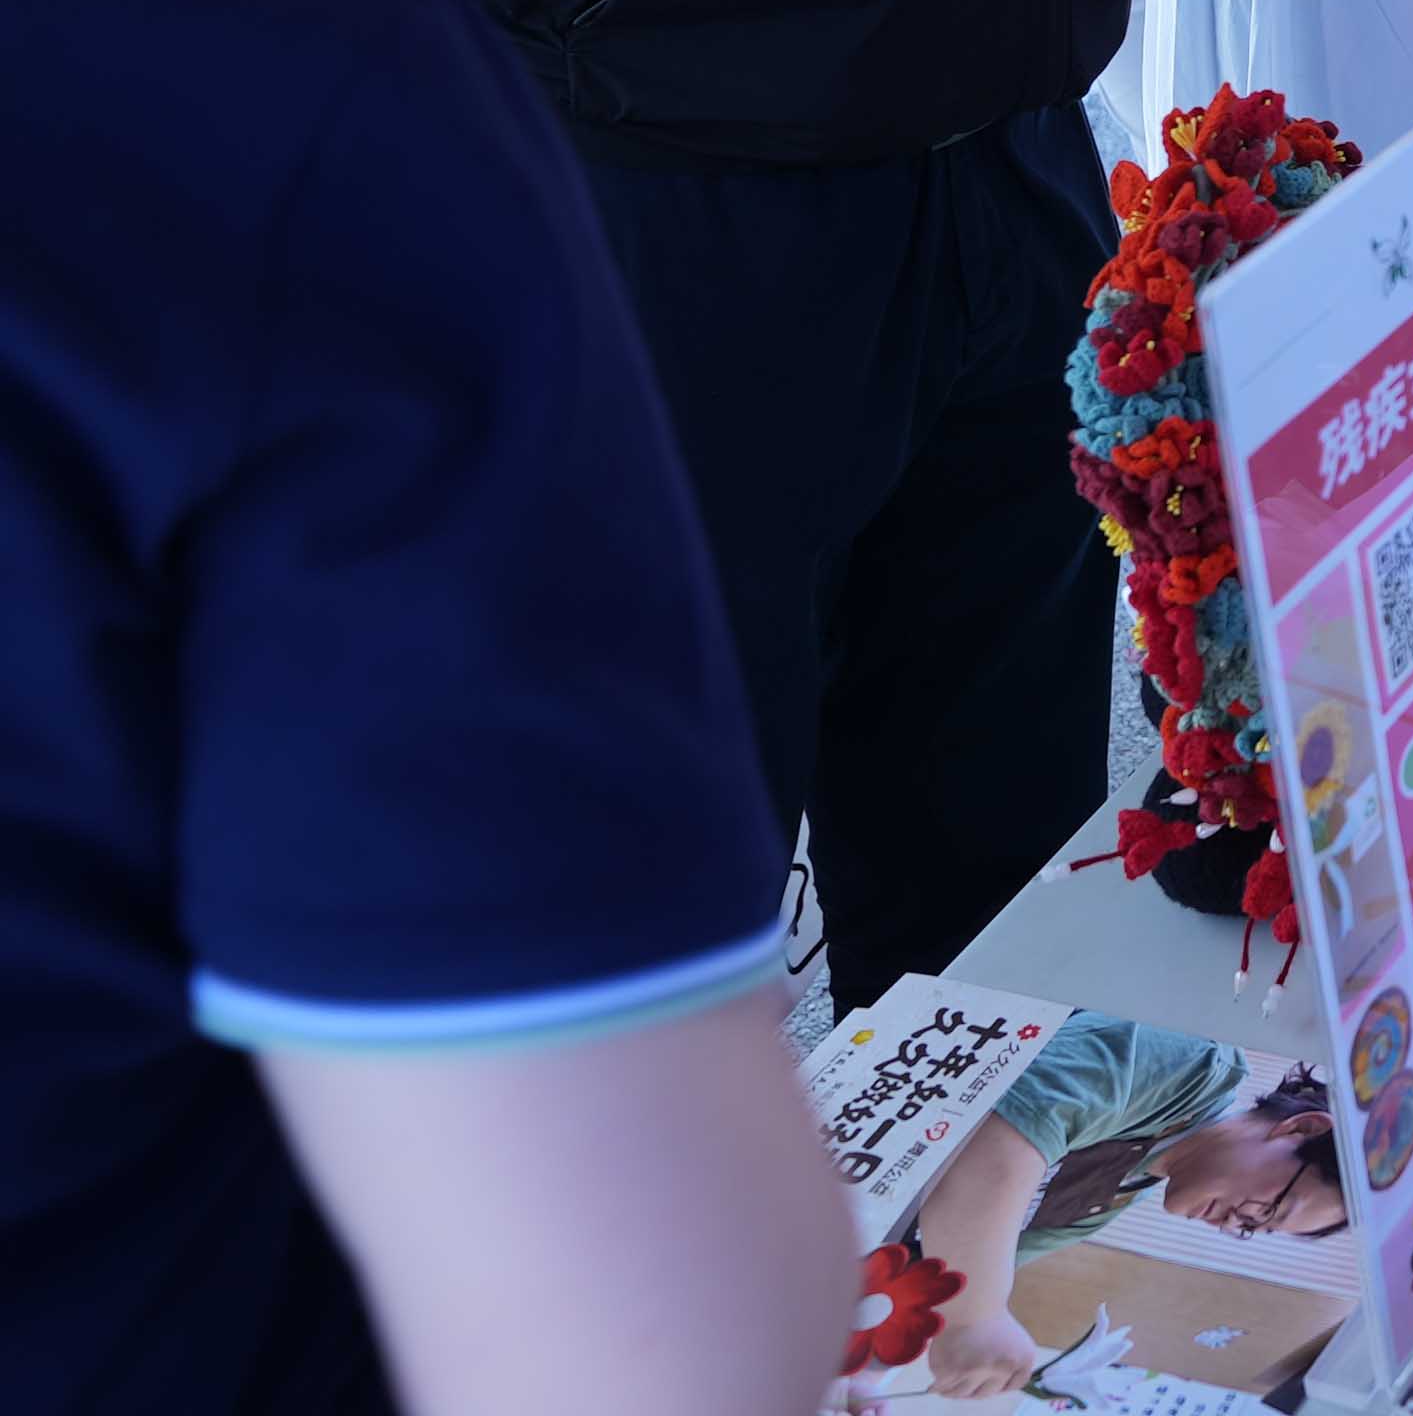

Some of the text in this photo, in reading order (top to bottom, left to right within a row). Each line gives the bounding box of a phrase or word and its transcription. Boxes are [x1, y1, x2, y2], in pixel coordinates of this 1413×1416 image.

[838, 1015, 1009, 1186] 十年如一日
[958, 1040, 1021, 1106] 久久公益节
